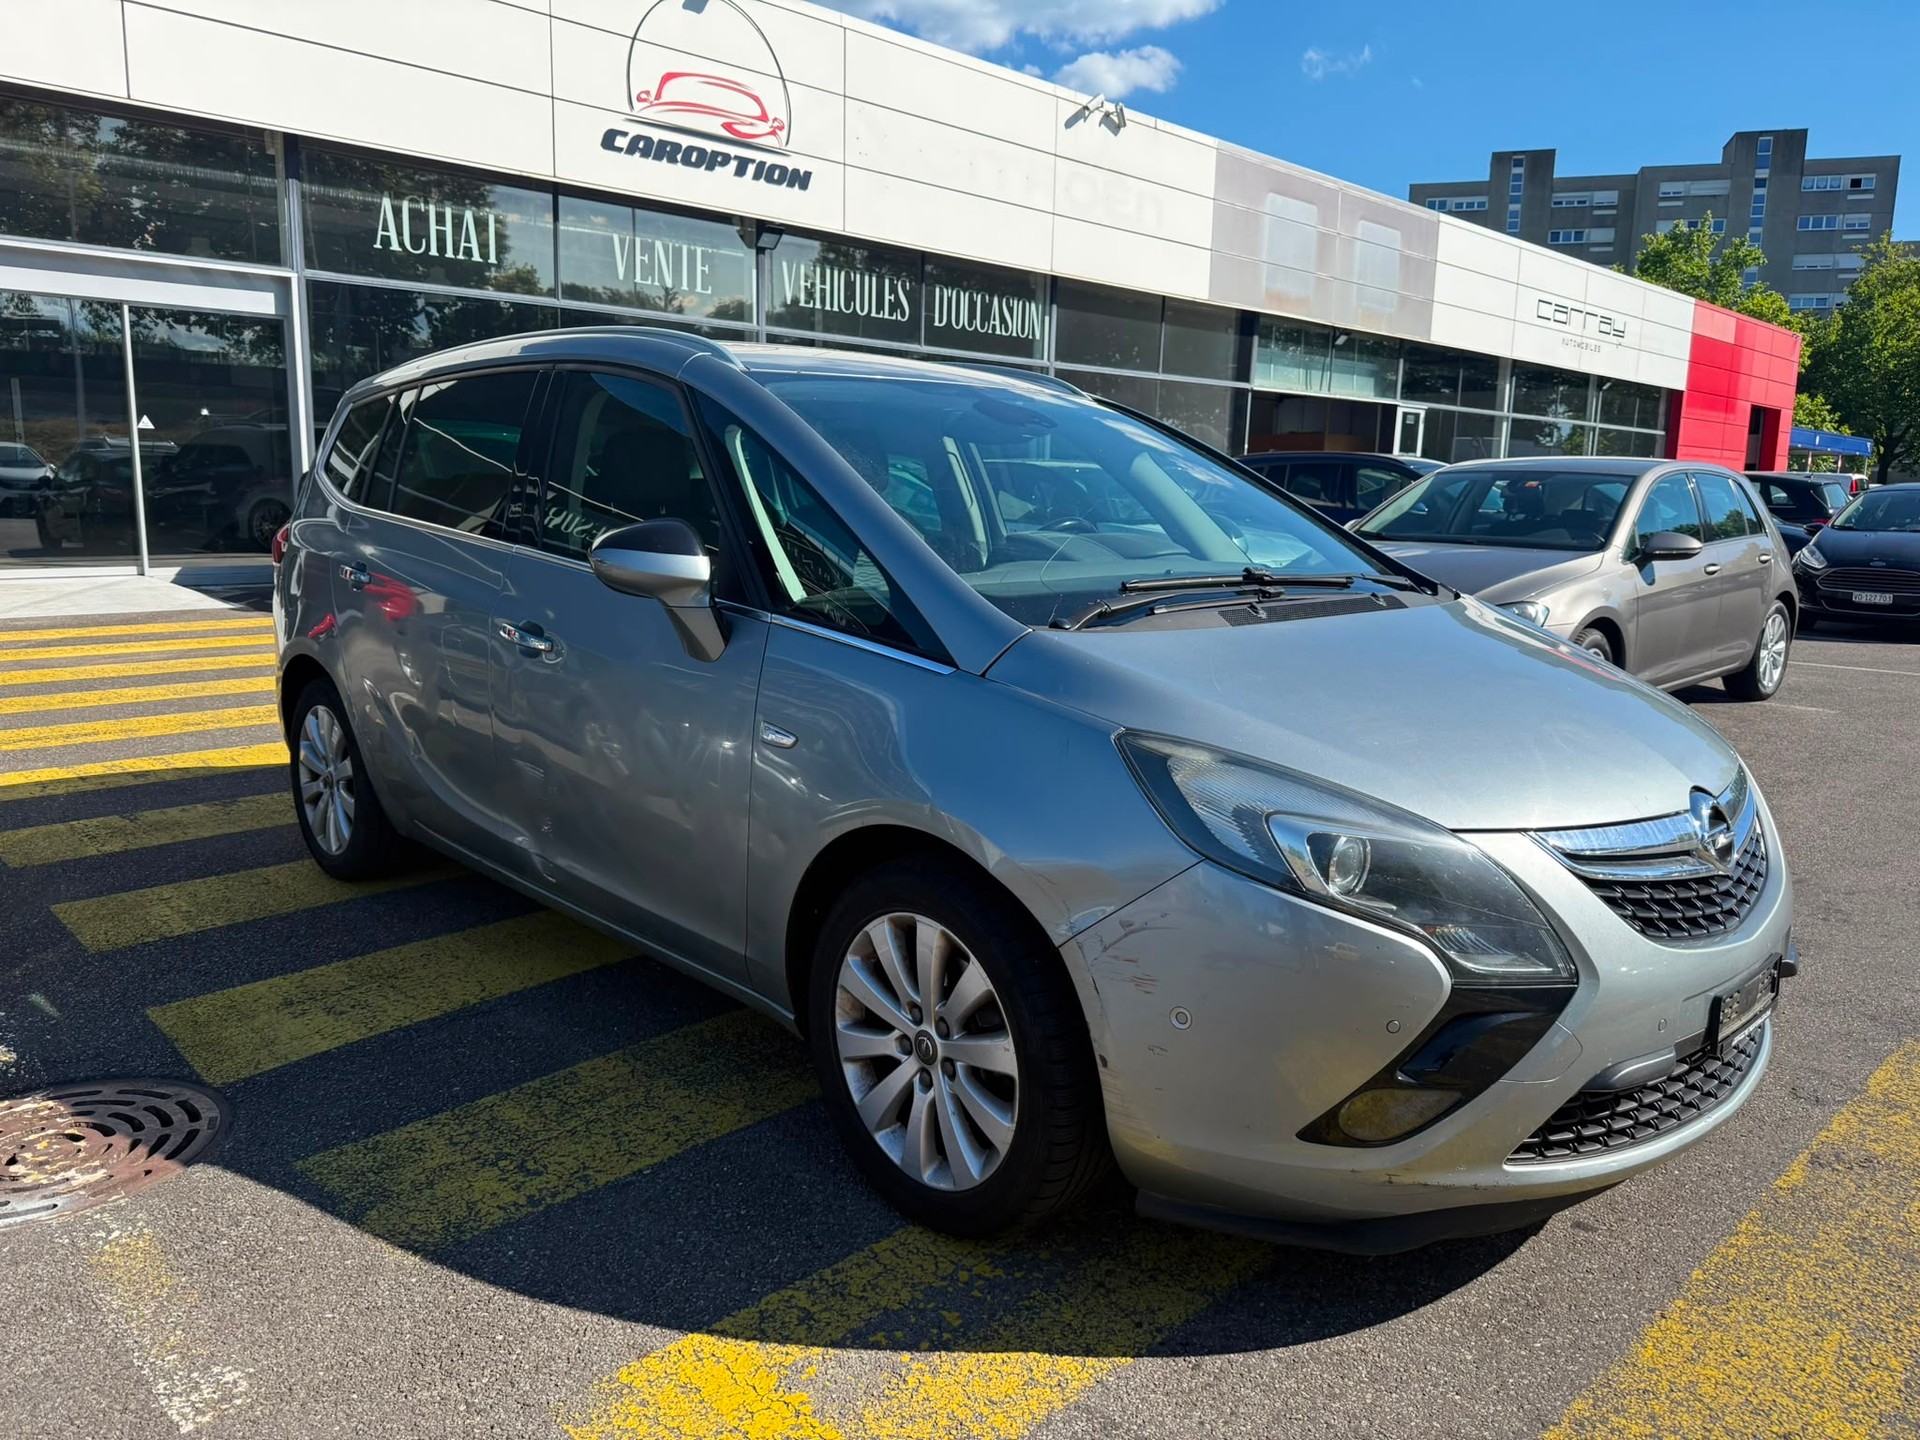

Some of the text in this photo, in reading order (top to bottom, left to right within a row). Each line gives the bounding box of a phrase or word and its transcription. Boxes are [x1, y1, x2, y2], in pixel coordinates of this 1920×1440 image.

[600, 128, 812, 191] CAROPTION
[933, 284, 1043, 340] D'OCCASION
[1536, 299, 1626, 338] carray
